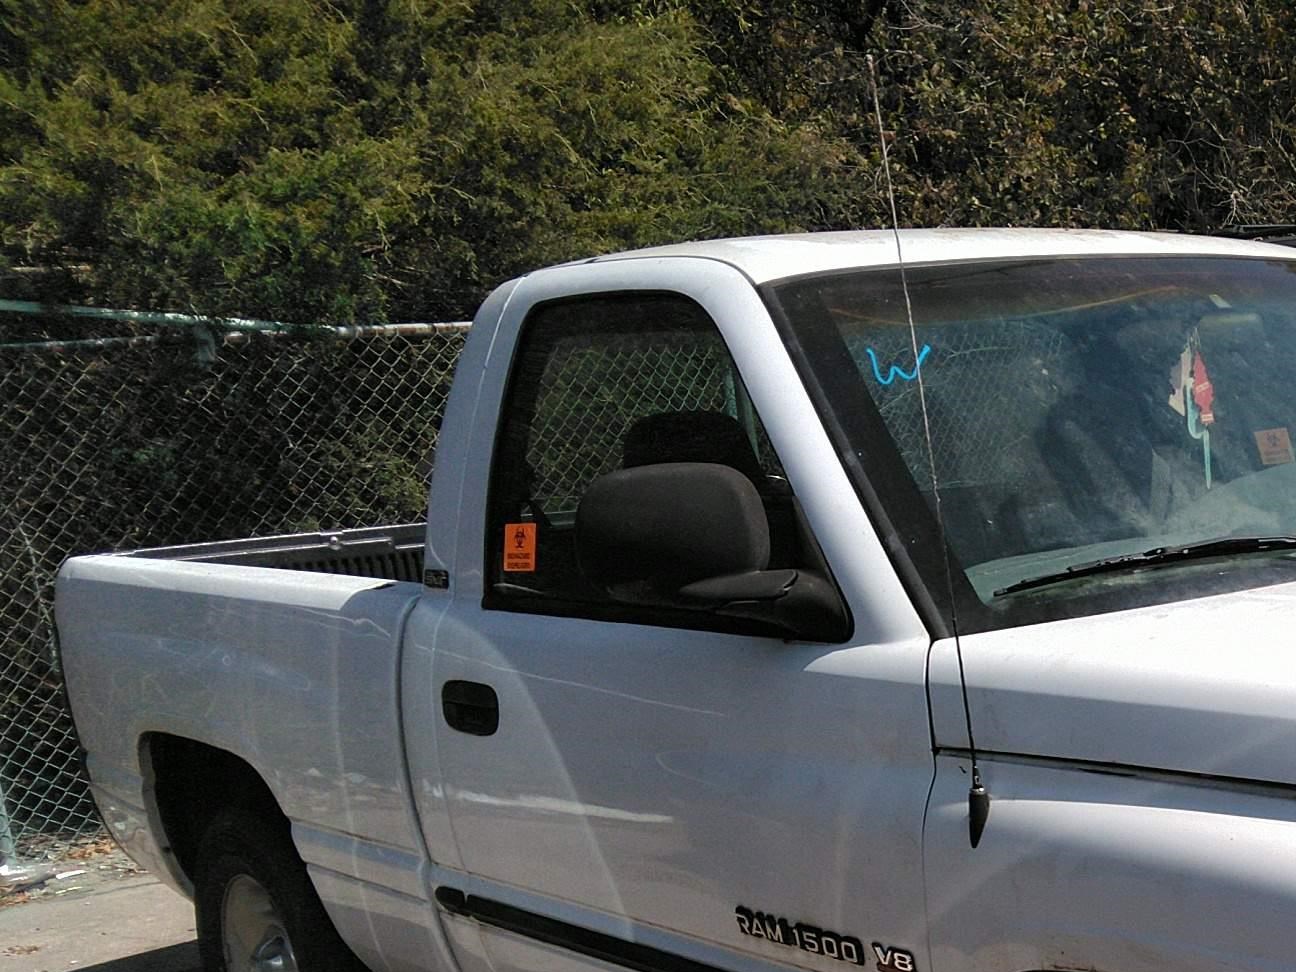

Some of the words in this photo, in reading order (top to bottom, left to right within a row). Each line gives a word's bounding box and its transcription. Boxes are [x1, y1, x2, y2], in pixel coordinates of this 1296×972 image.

[865, 343, 931, 385] W
[735, 907, 786, 944] RAM
[793, 924, 863, 965] 1500
